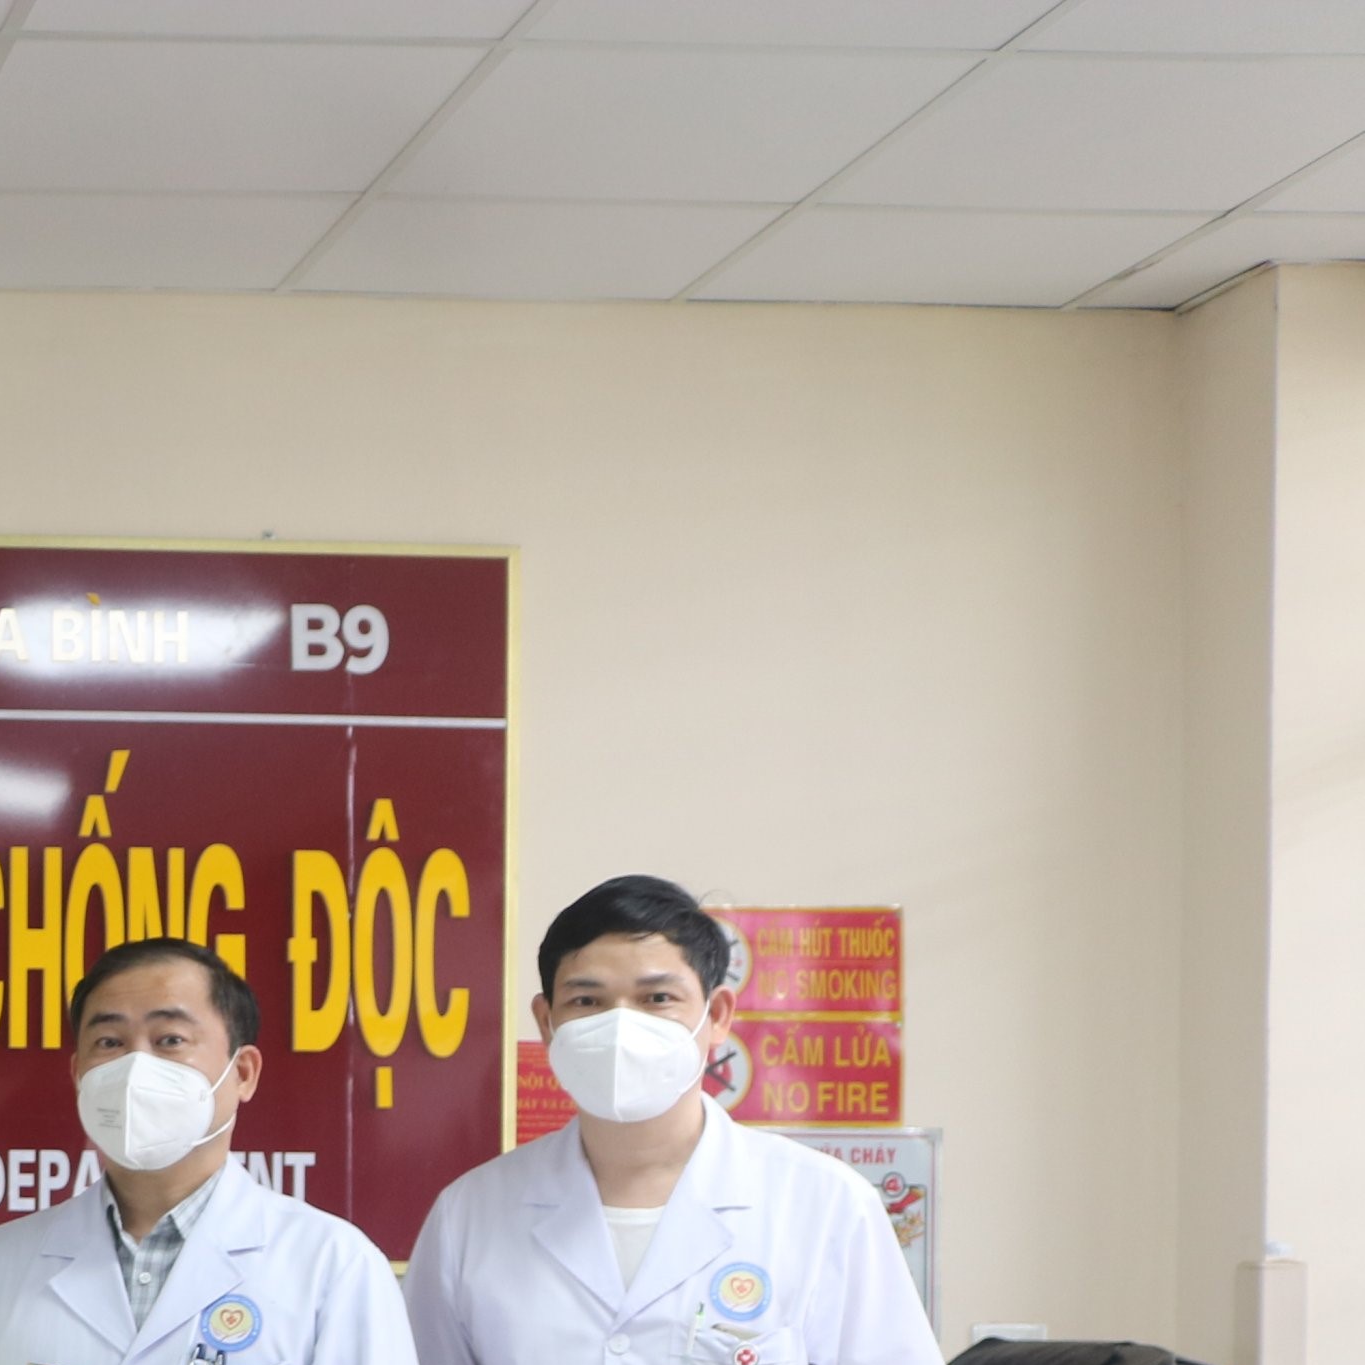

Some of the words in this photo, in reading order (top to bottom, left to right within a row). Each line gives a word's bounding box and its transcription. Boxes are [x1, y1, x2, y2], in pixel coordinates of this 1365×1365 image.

[51, 592, 190, 664] BÌNH
[290, 603, 391, 675] B9
[287, 798, 471, 1109] ĐỘC
[795, 968, 897, 1001] SMOKING
[759, 1023, 825, 1069] CẤM
[762, 1081, 811, 1114] NO
[817, 1081, 890, 1115] FIRE
